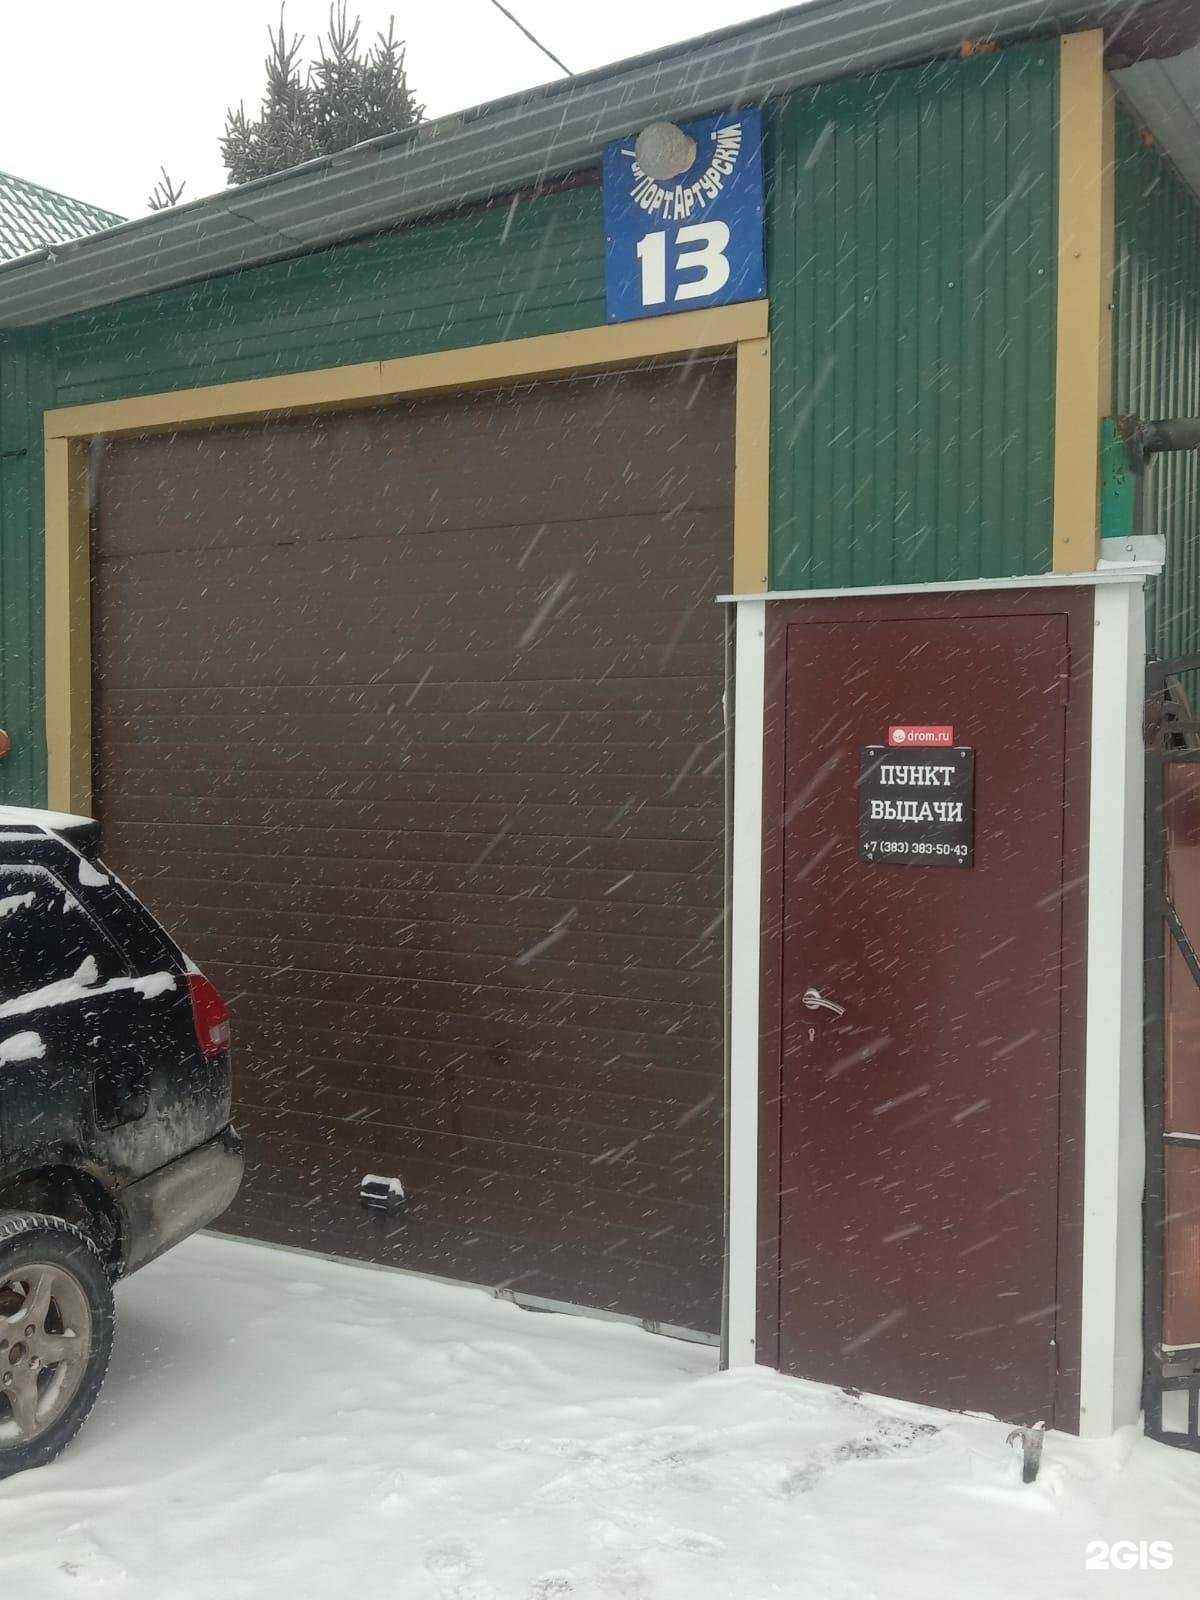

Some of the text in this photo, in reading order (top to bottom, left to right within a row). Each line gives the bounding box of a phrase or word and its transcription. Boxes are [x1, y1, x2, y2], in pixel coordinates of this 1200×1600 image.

[637, 221, 730, 306] 13
[907, 730, 950, 741] drom.ru
[880, 765, 955, 786] ПУНКТ
[870, 800, 963, 823] ВЫДАЧИ
[864, 841, 968, 856] +7 (383) 383-50-43
